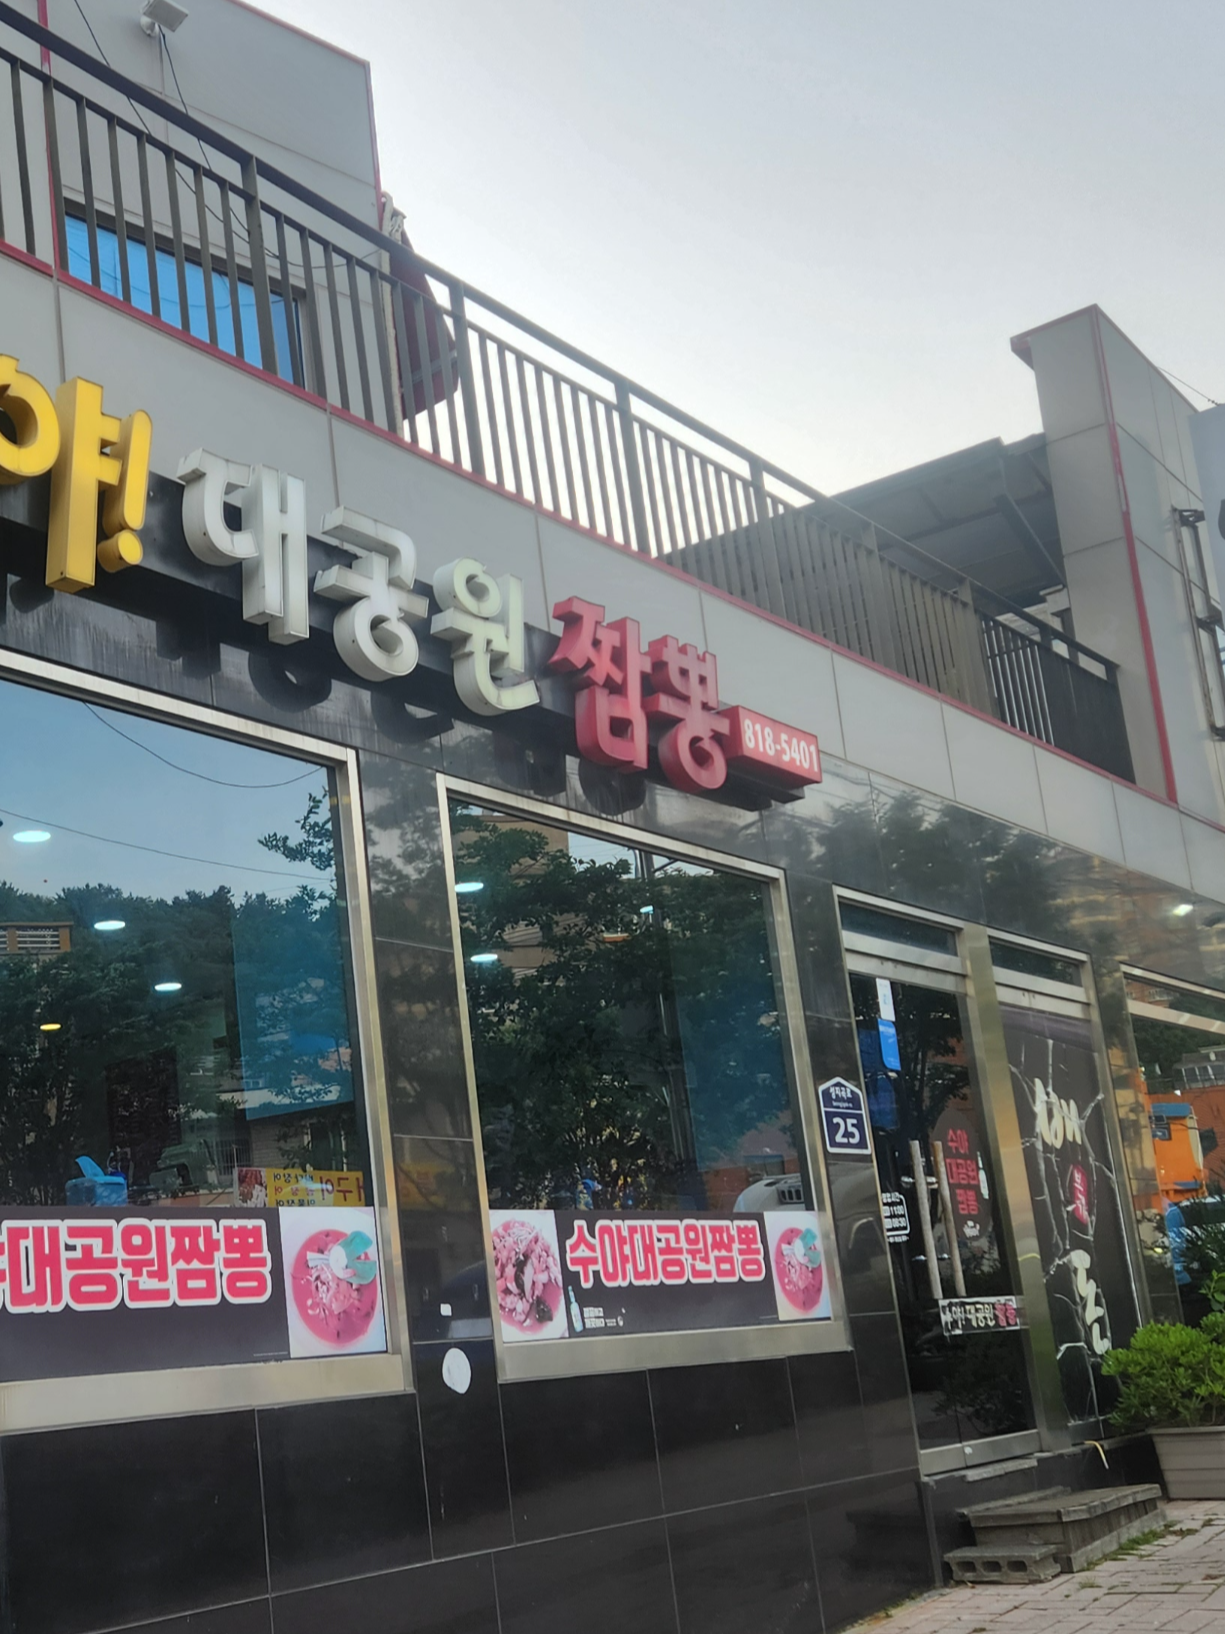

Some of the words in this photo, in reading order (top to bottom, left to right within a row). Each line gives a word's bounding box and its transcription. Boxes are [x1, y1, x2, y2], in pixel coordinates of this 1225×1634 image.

[177, 448, 539, 715] 대공원
[548, 596, 729, 793] 짬뽕
[744, 718, 818, 772] 818-5401
[832, 1116, 860, 1144] 25
[566, 1218, 766, 1288] 수야대공원짬뽕
